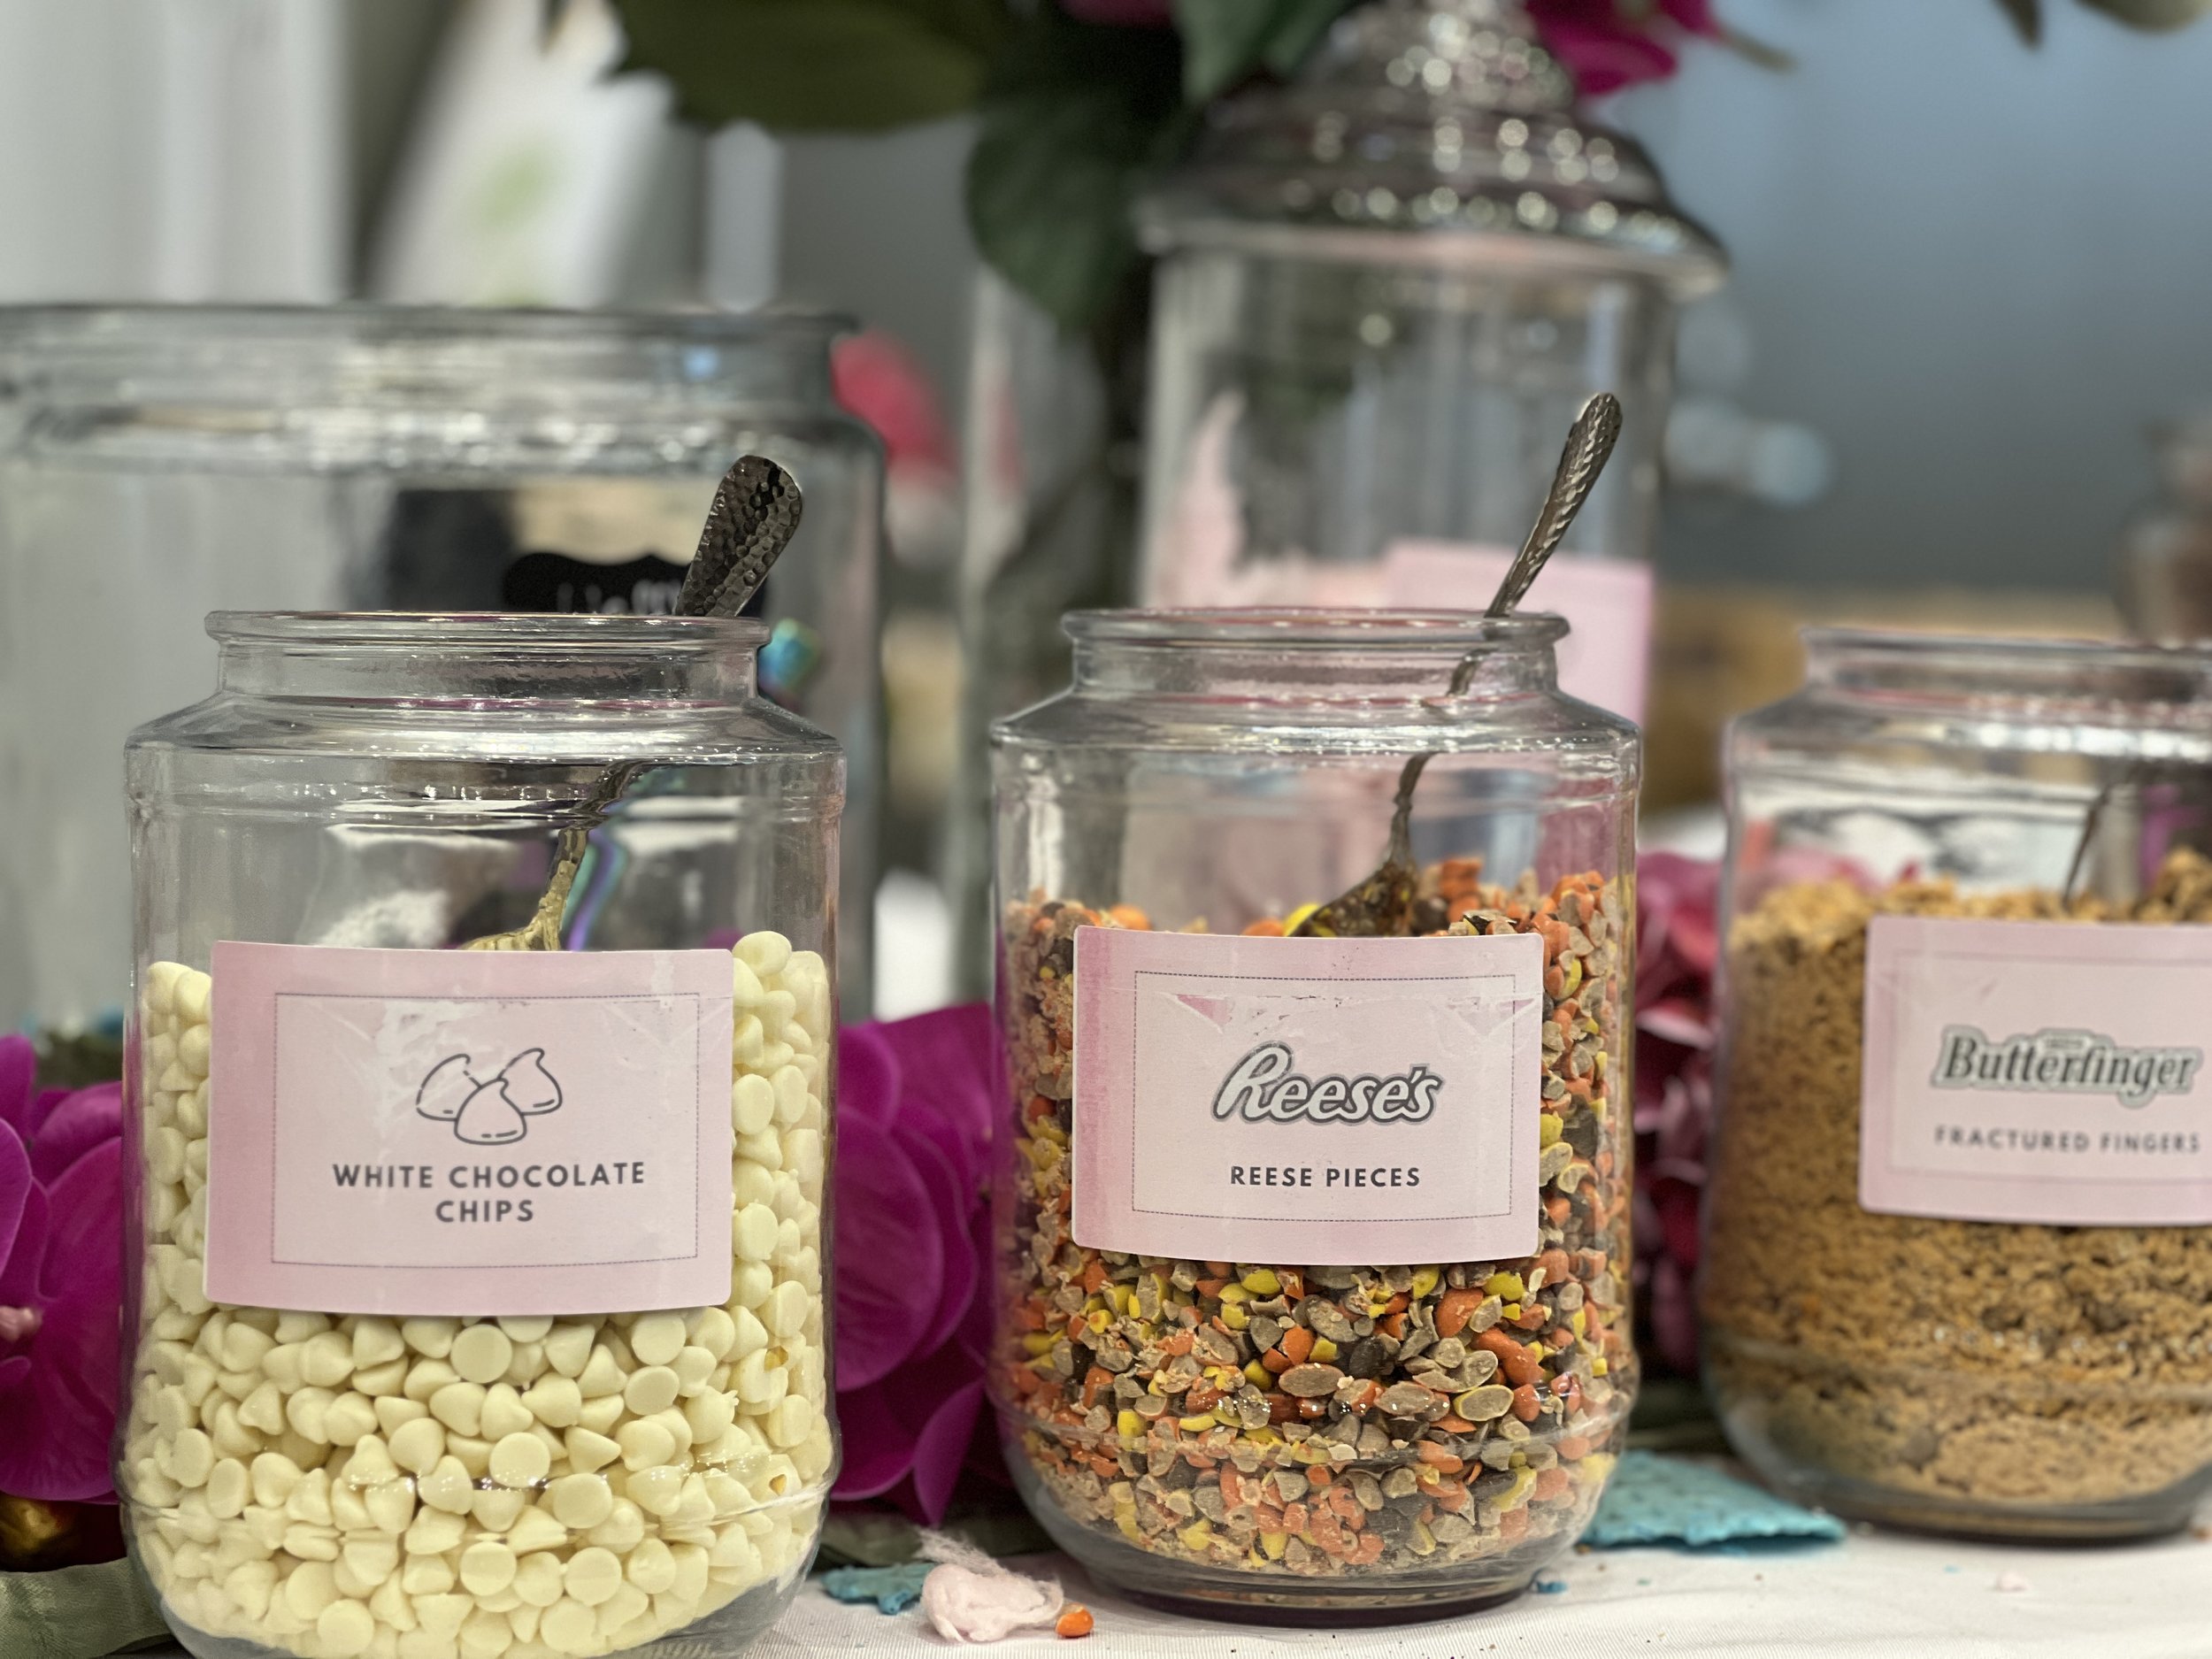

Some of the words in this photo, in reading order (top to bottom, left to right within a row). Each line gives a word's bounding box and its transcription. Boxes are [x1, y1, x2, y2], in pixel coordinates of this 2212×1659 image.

[1938, 1026, 2201, 1102] Butterfinger
[1213, 1041, 1441, 1123] Reese's
[1934, 1124, 2090, 1151] FRACTURED
[2100, 1132, 2200, 1153] FINGERS
[333, 1163, 434, 1188] WHITE
[449, 1161, 645, 1188] CHOCOLATE
[1230, 1165, 1312, 1187] REESE
[1325, 1166, 1420, 1188] PIECES
[435, 1199, 534, 1223] CHIPS
